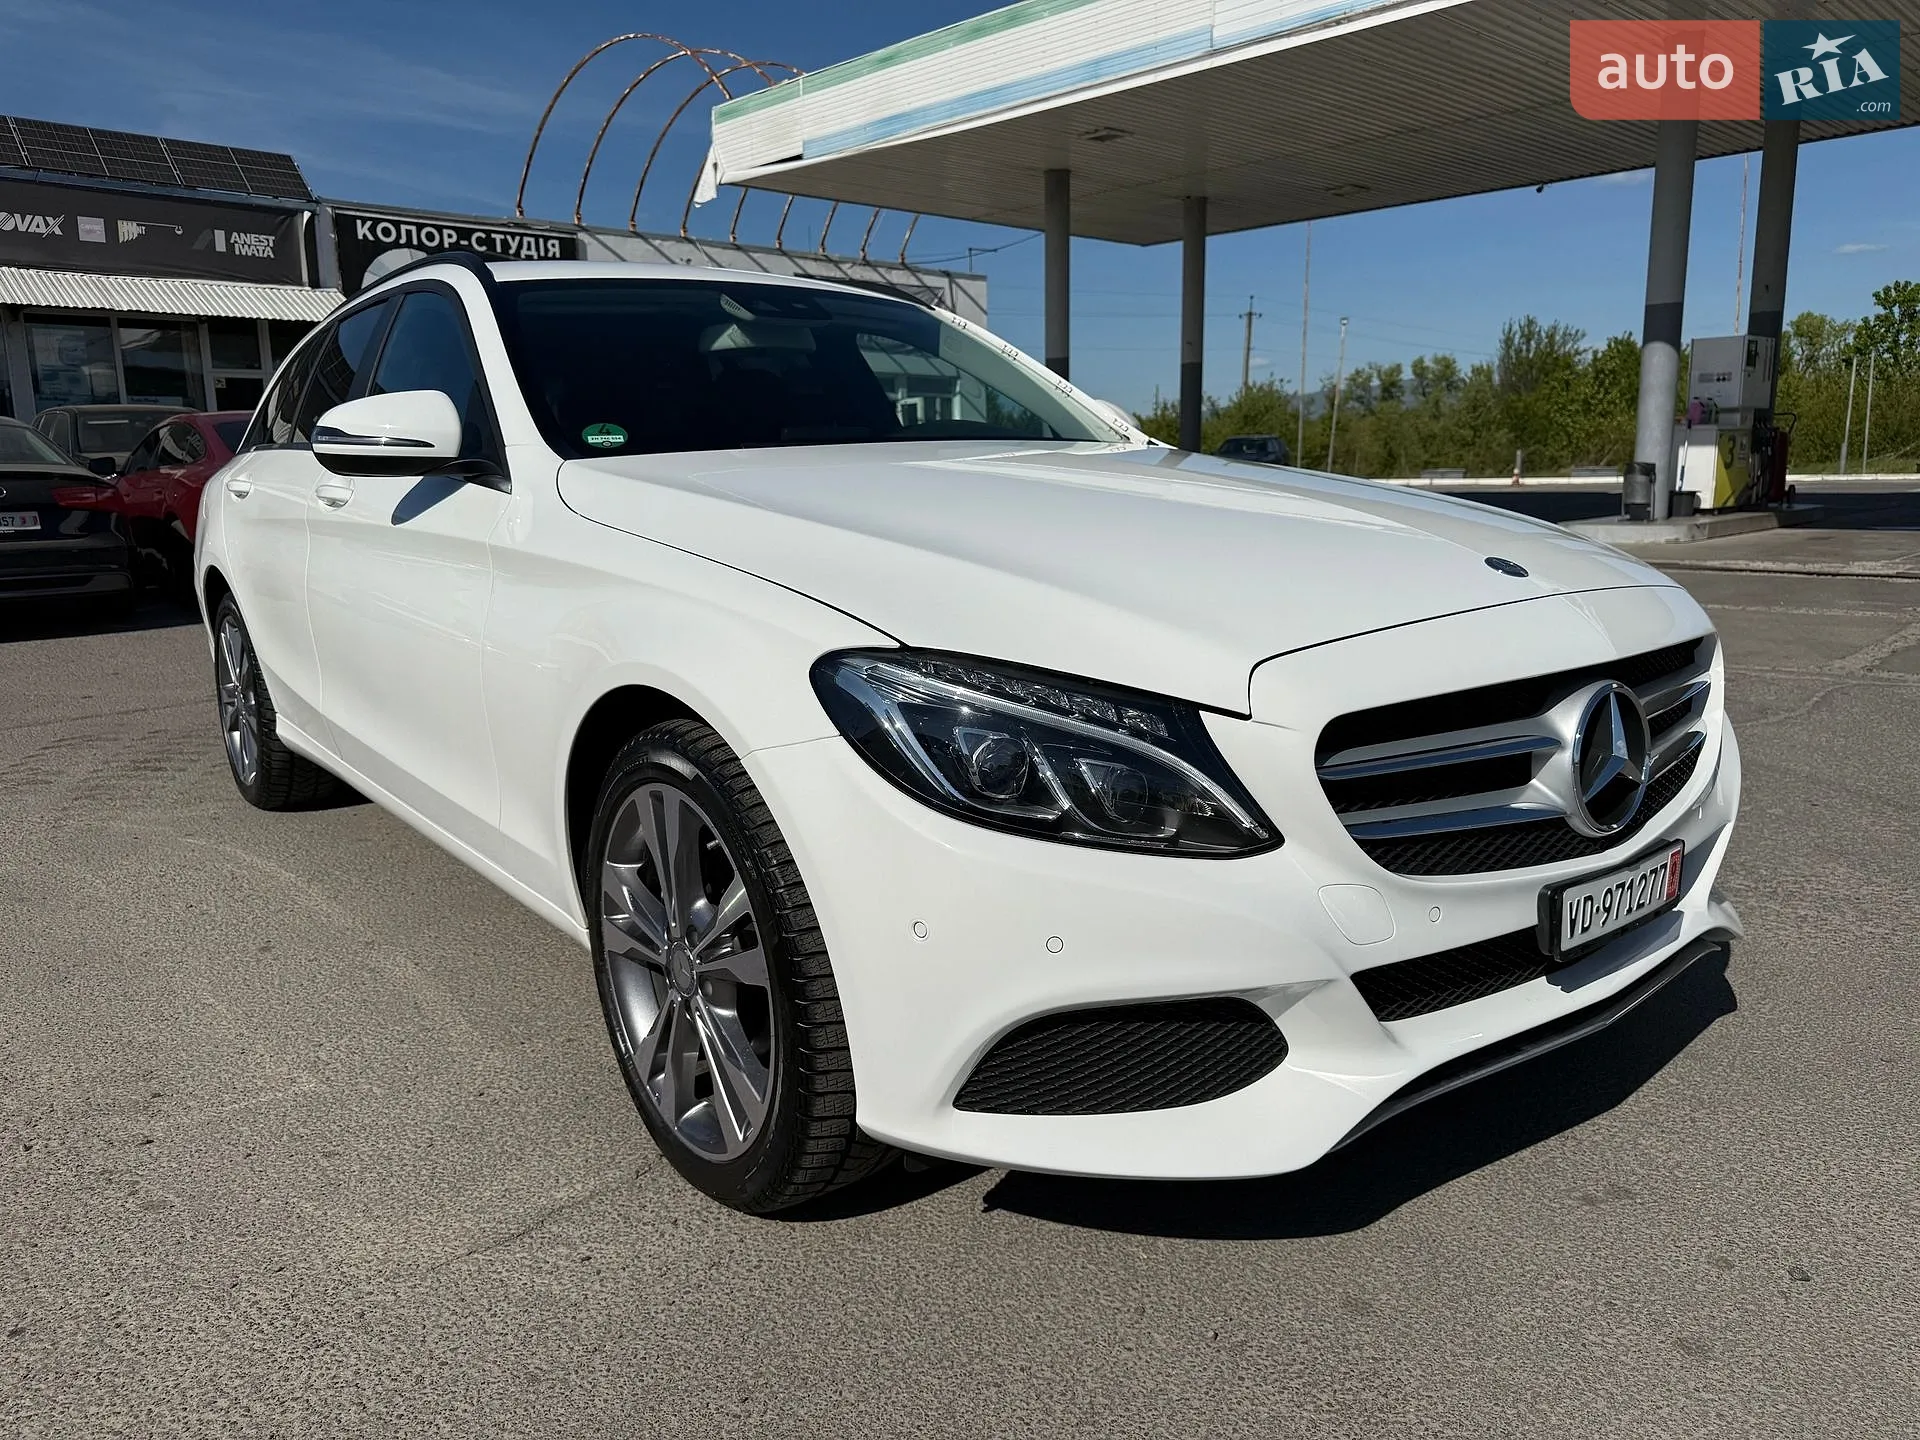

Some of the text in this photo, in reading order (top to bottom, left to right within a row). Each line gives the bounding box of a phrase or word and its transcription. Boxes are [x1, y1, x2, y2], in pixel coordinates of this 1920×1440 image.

[230, 231, 276, 248] ANEST
[356, 218, 561, 260] КОЛОР-СТУДІЯ
[234, 243, 275, 259] IWATA
